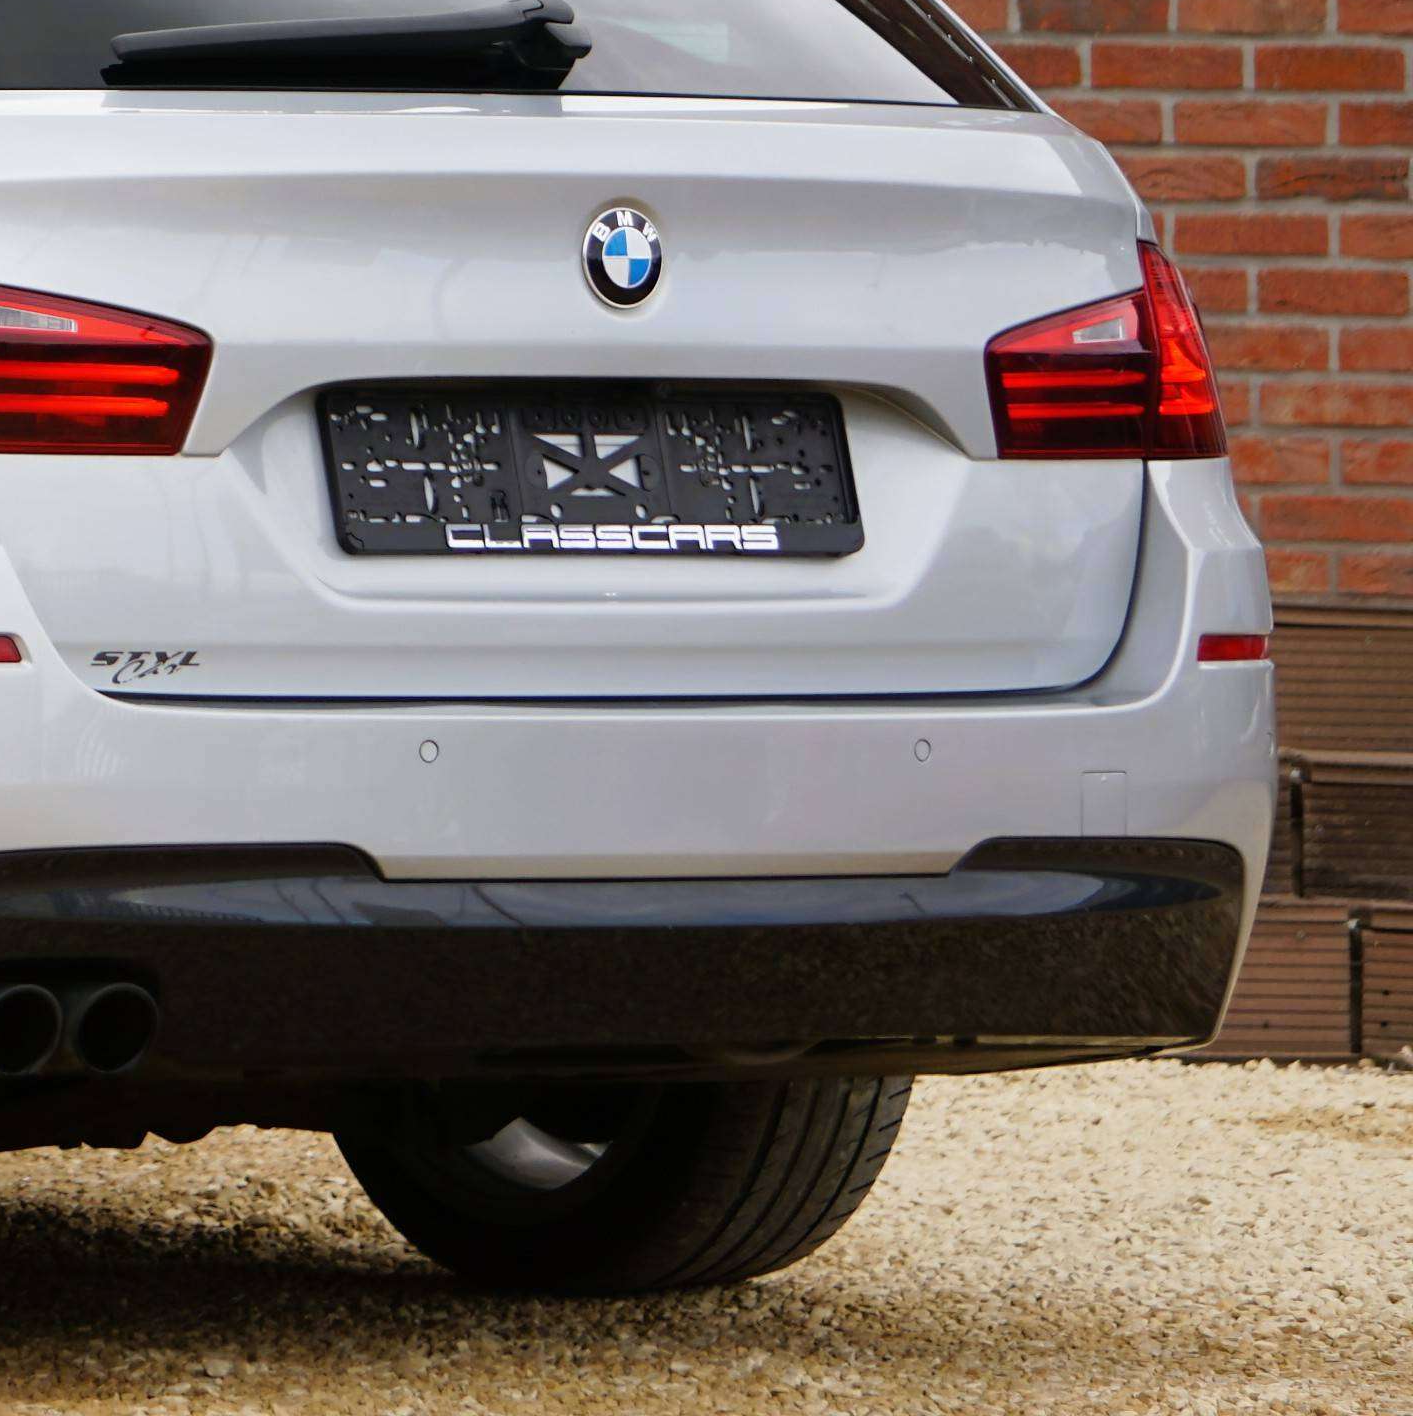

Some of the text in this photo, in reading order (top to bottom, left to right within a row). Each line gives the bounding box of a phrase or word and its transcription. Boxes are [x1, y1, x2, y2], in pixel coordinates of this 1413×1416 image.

[591, 210, 658, 242] BMW
[445, 523, 780, 550] CLASSCARS
[90, 650, 200, 666] STYL
